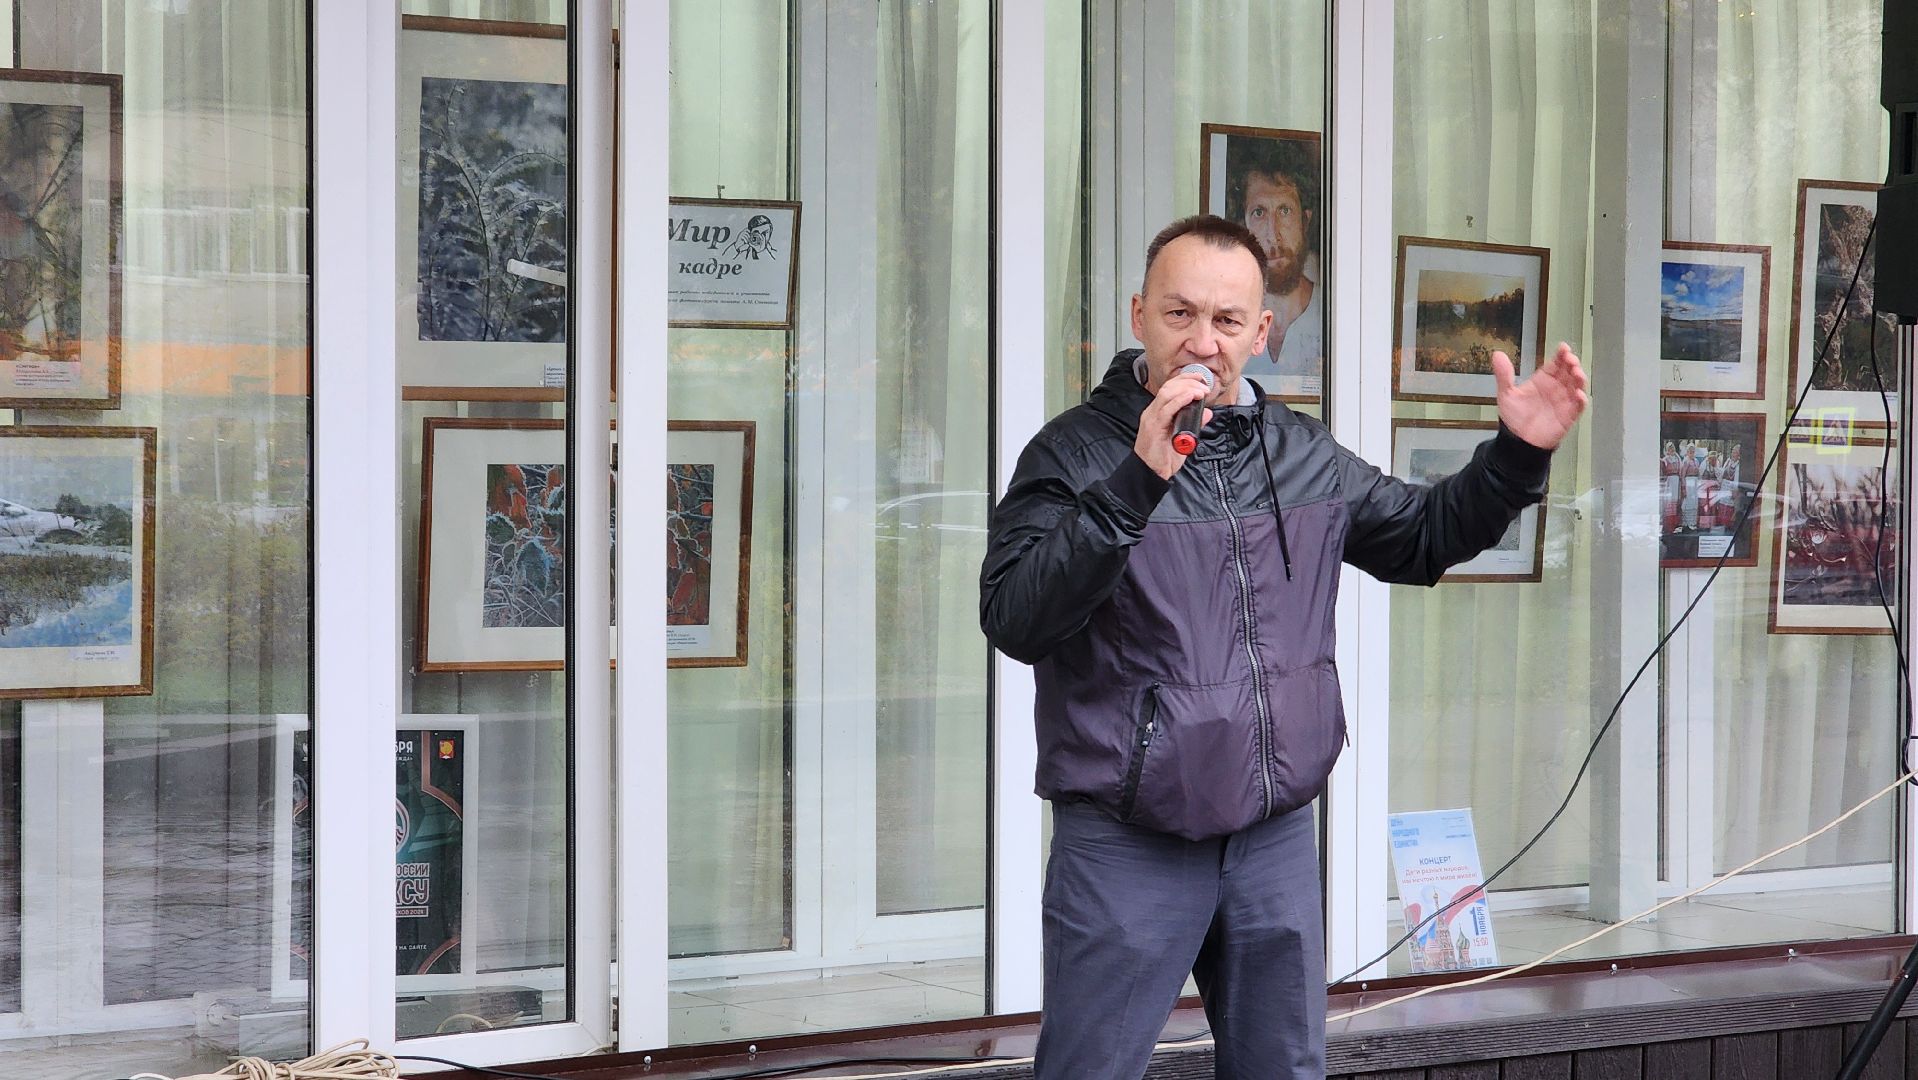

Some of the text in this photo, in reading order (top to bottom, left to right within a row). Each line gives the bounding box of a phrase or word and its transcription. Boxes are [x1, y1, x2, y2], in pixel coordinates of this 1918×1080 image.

[668, 218, 731, 249] Мир
[679, 258, 743, 280] кадре
[1419, 856, 1451, 866] КОНЦЕРТ
[1477, 906, 1488, 935] НОЯБРЯ
